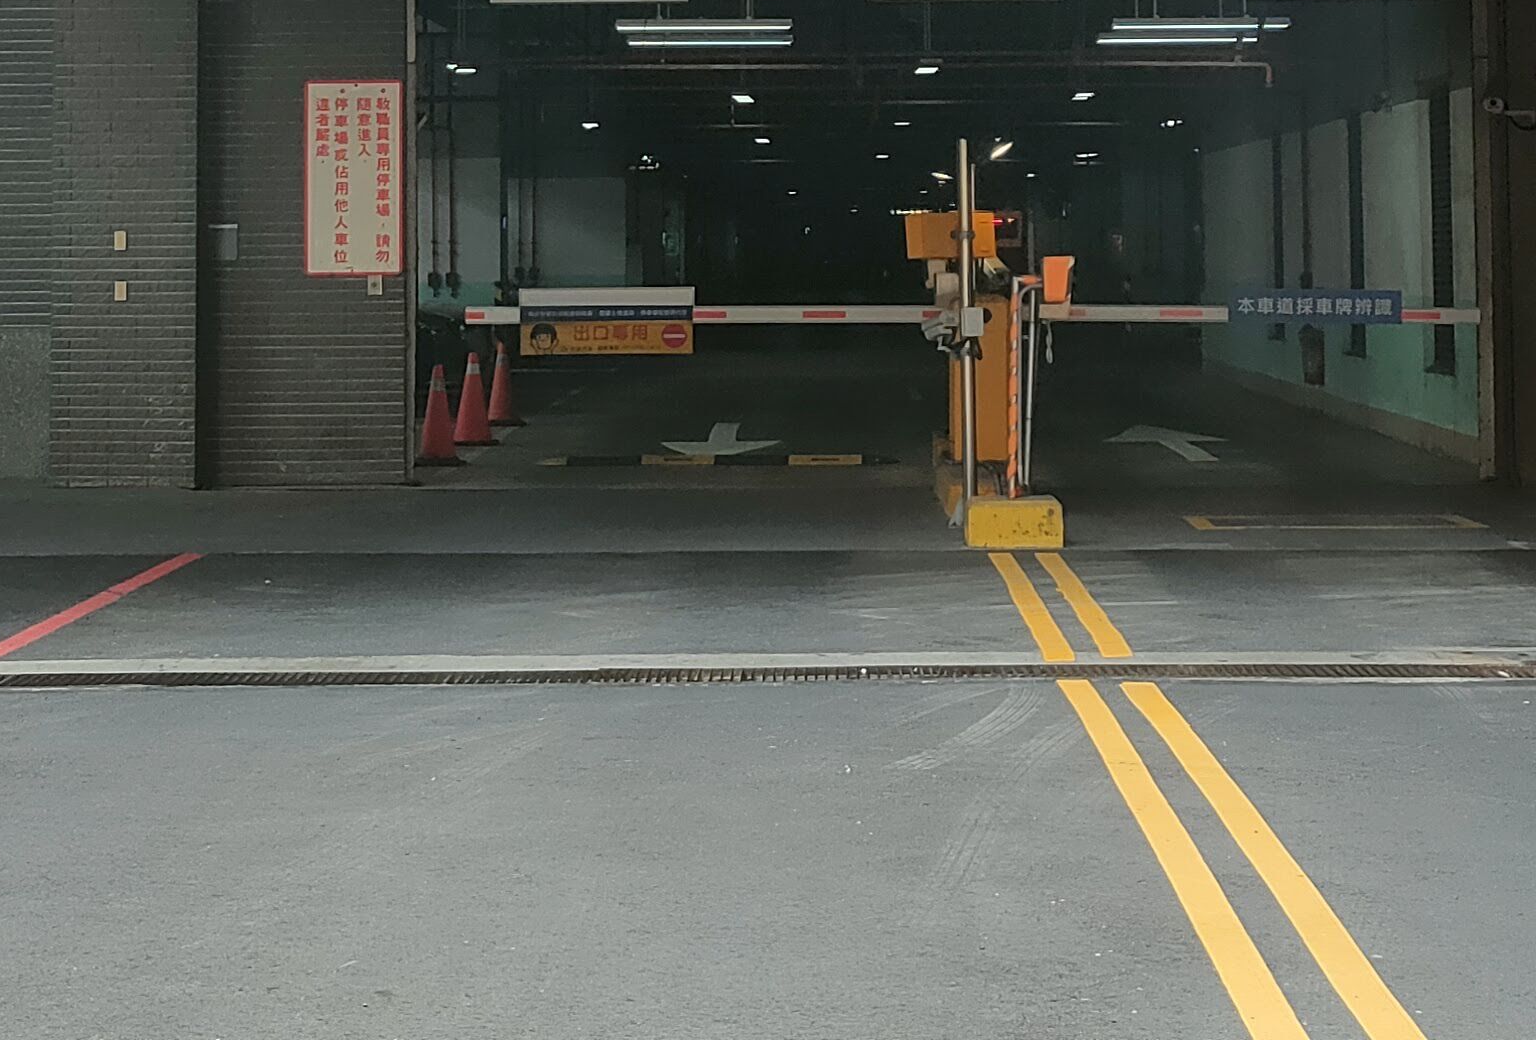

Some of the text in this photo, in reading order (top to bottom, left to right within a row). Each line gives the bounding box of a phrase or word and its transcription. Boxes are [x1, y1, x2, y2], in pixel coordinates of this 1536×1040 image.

[1237, 297, 1393, 316] 本車道採車牌辨識
